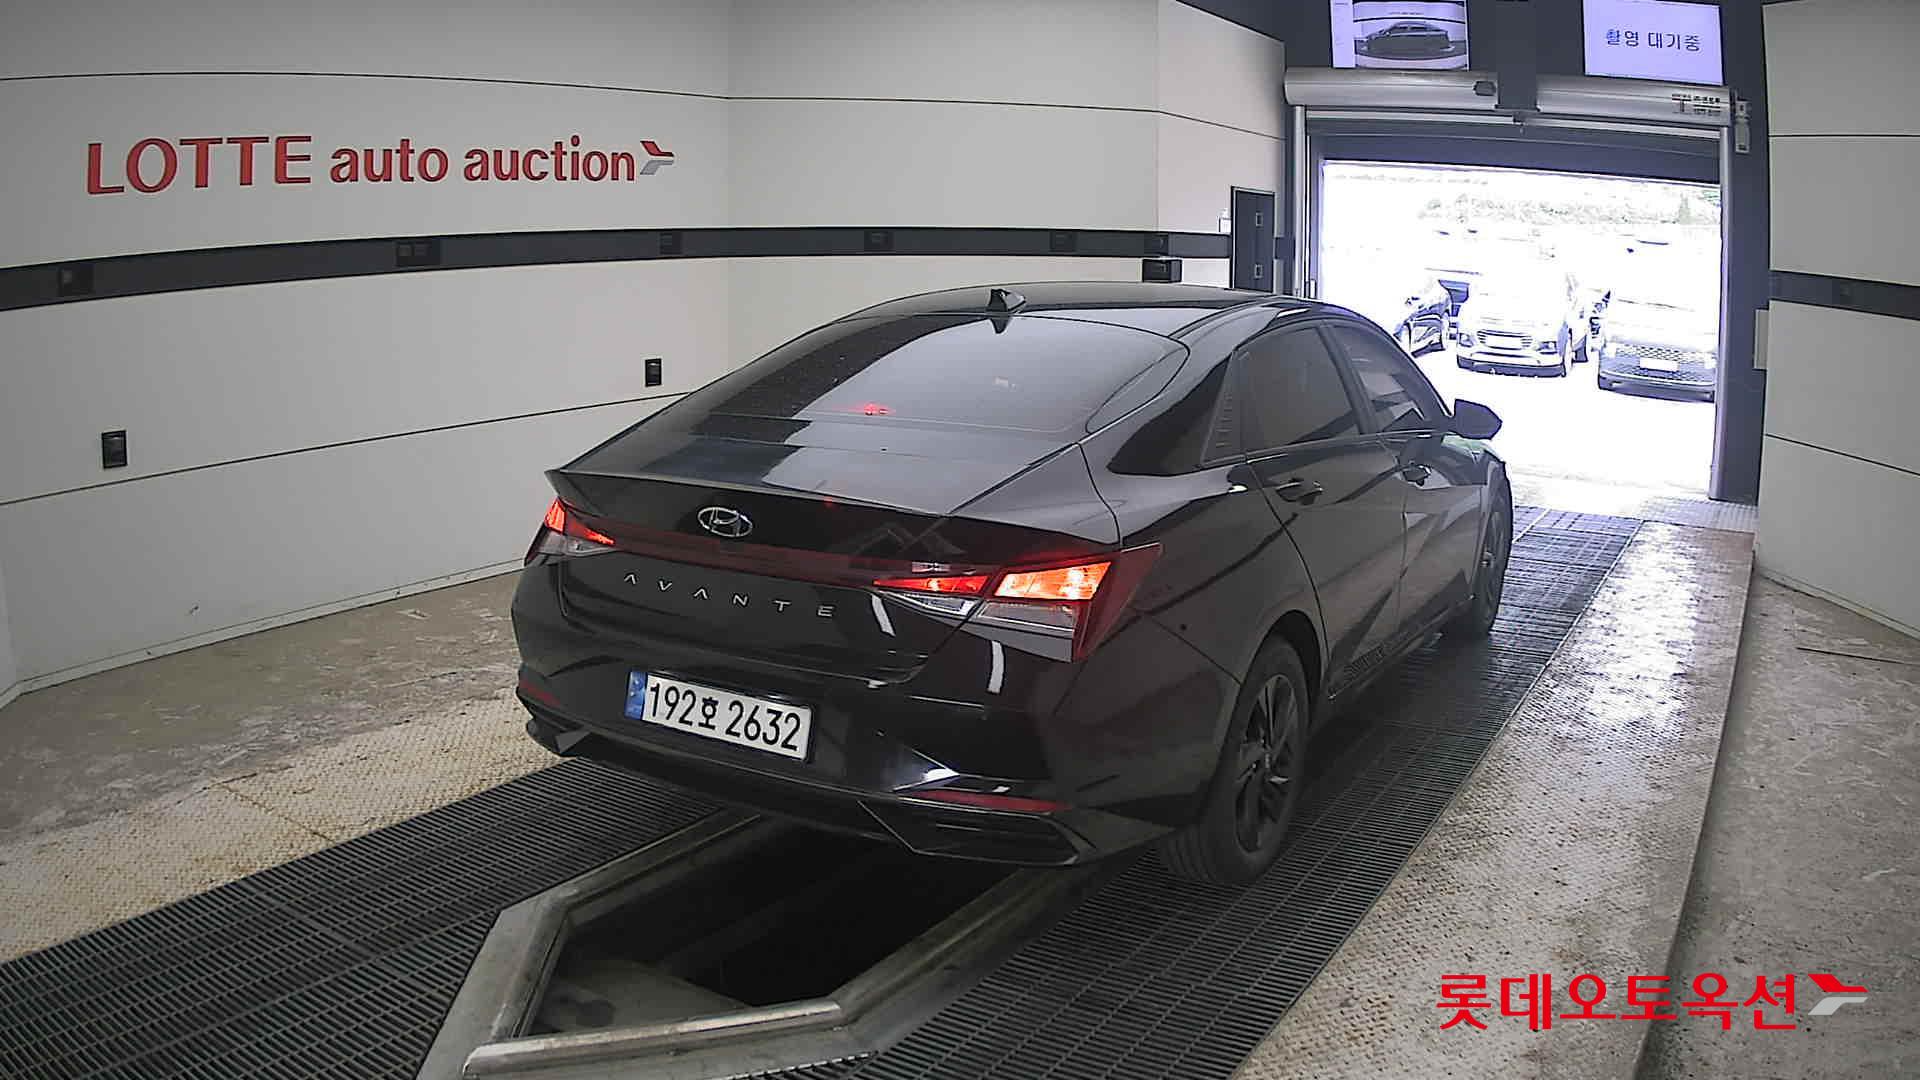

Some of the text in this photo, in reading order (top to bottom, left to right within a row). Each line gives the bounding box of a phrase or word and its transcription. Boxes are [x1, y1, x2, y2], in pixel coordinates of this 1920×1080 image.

[1647, 31, 1702, 52] 대기중
[87, 135, 636, 195] LOTTE auto auction
[623, 572, 835, 618] AVANTE
[725, 700, 802, 751] 2632
